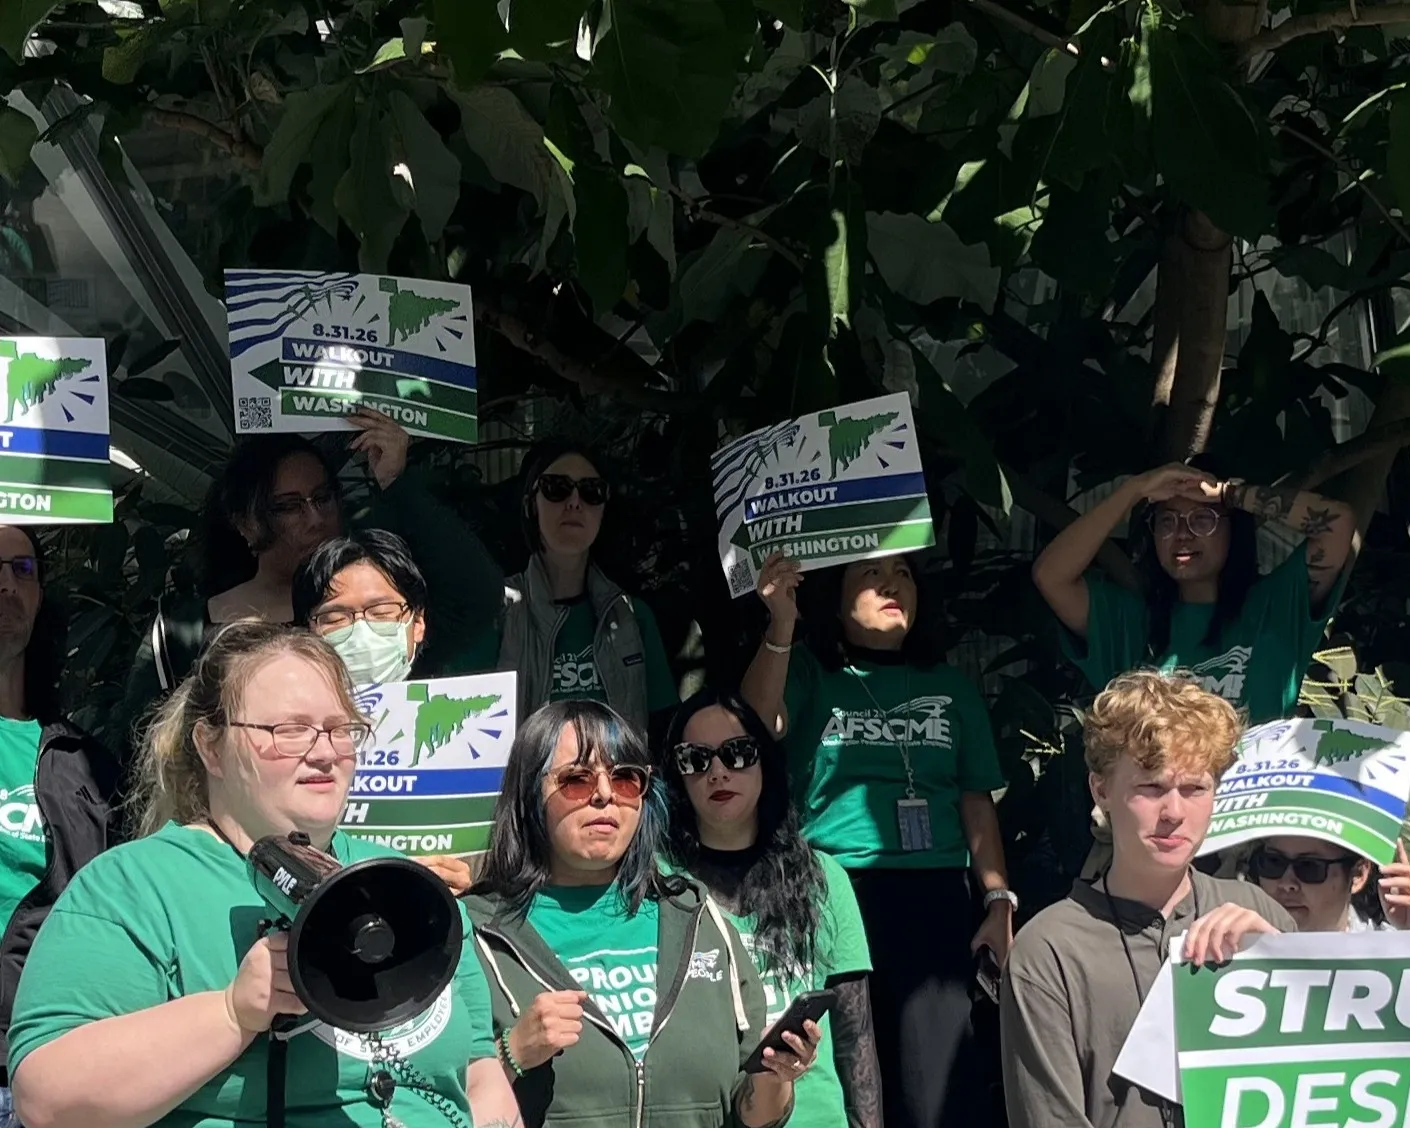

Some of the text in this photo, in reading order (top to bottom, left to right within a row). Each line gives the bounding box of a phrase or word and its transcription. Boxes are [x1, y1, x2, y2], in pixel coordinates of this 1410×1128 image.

[312, 323, 378, 343] 8.31.26
[292, 342, 394, 367] WALKOUT
[283, 366, 356, 389] WITH
[293, 396, 427, 426] WASHGTON
[765, 468, 821, 489] 8.31.26
[751, 487, 838, 514] WALKOUT
[747, 514, 803, 542] WITH
[820, 716, 952, 743] AFSCME
[359, 750, 400, 766] 1.26
[1236, 759, 1300, 774] 8.31.26
[349, 775, 418, 793] KOUT
[272, 866, 298, 895] PYLE
[568, 963, 658, 990] PROU
[588, 987, 658, 1013] NIO
